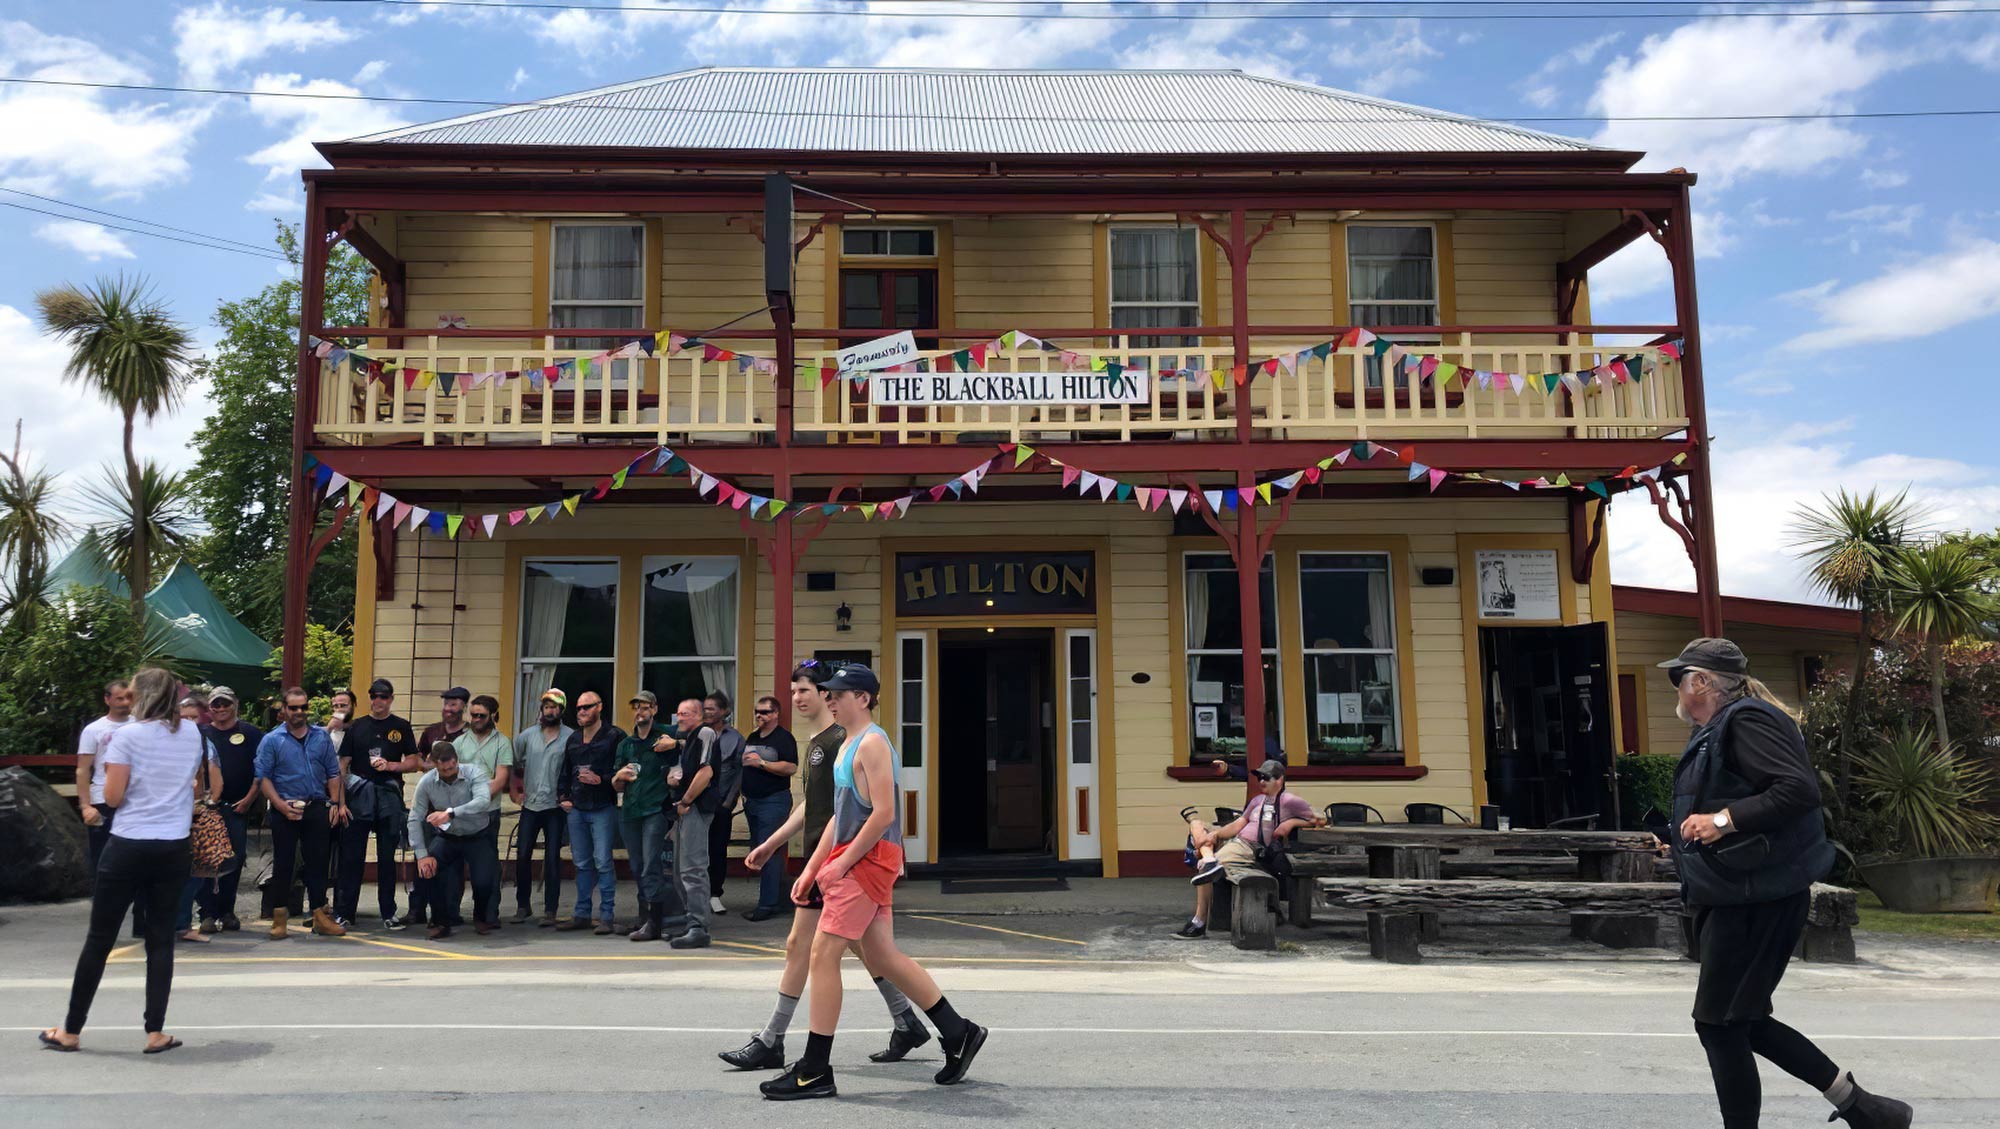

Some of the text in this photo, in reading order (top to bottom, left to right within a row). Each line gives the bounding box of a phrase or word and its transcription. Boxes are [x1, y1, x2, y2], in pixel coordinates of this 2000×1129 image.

[880, 375, 1138, 401] THE BLACKBALL HILTON
[903, 563, 1088, 601] HILTON
